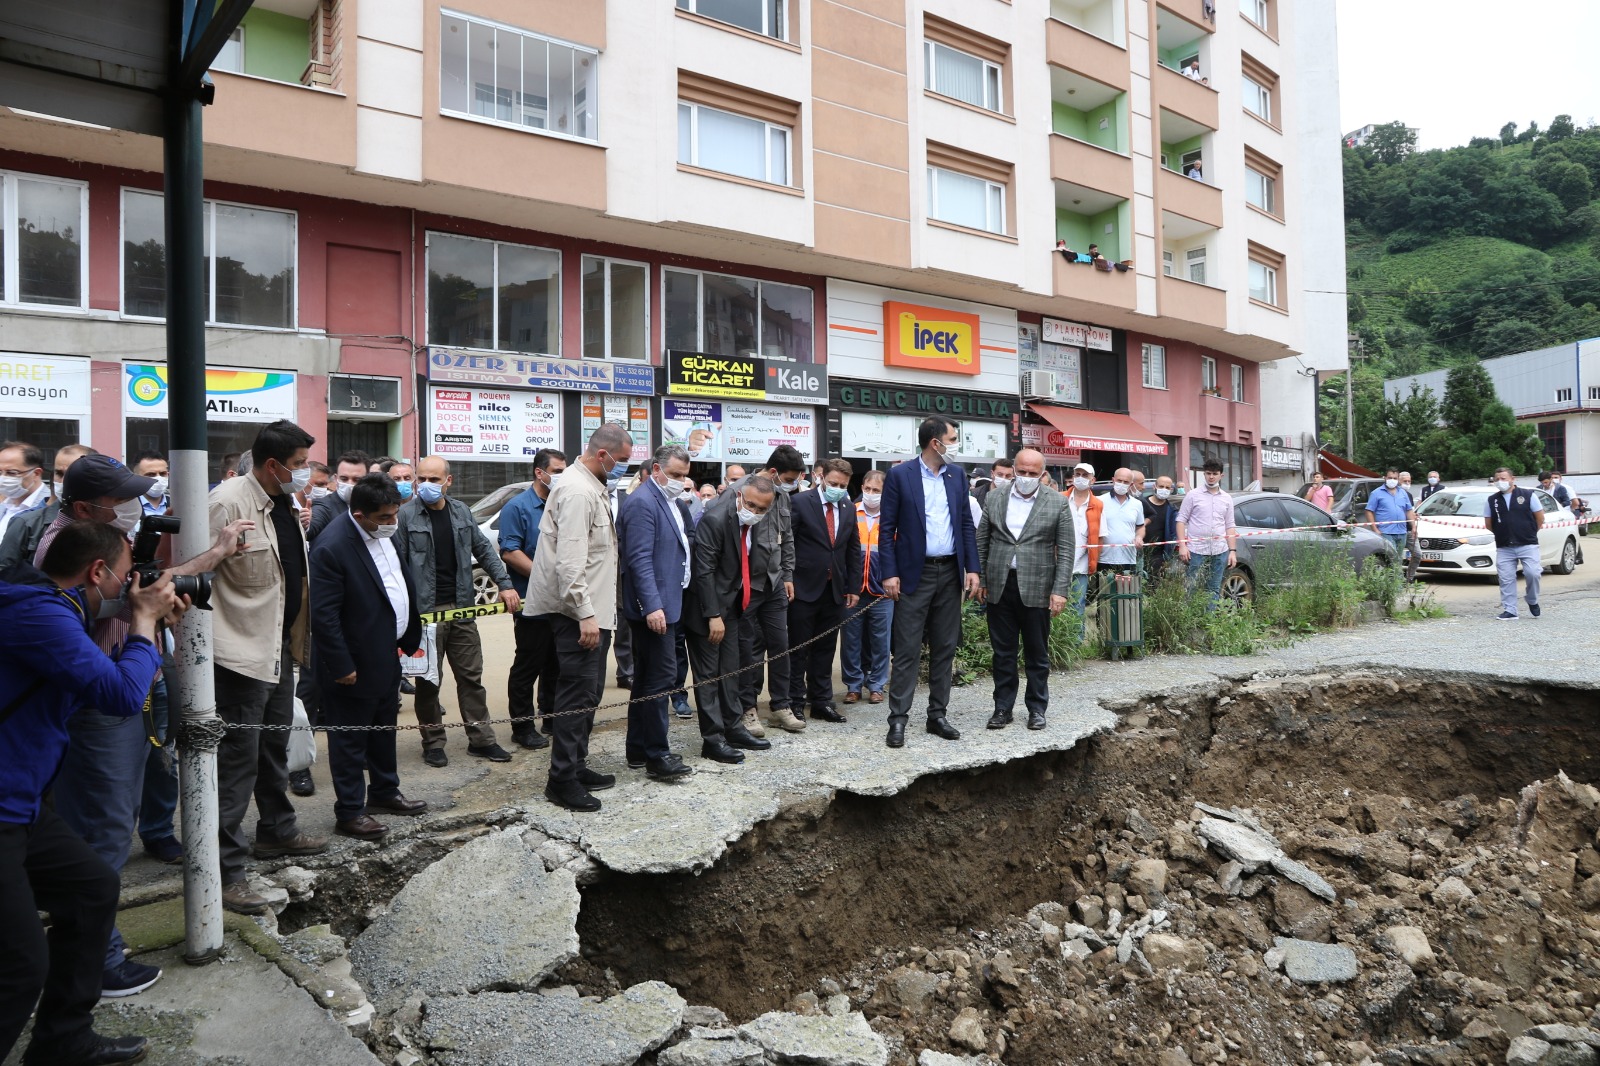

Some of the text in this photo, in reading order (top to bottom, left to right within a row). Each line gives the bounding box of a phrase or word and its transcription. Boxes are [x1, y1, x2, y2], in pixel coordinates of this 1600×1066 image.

[914, 322, 958, 354] İPEK
[1087, 328, 1109, 342] HOME
[432, 350, 612, 379] ÖZER TEKNİK
[682, 355, 754, 374] GÜRKAN
[447, 372, 508, 382] ISITMA
[681, 369, 755, 387] TİCARET
[778, 368, 819, 391] Kale
[541, 378, 599, 390] SOĞUTMA
[0, 386, 68, 400] orasyon
[446, 391, 469, 400] arçelik
[439, 402, 469, 410] VESTEL
[840, 386, 1011, 417] GENÇ MOBİLYA
[478, 403, 511, 412] nilco
[436, 412, 471, 422] BOSCH
[478, 413, 512, 422] SIEMENS
[436, 423, 472, 433] AEG
[525, 425, 554, 434] SHARP
[480, 432, 509, 441] ESKAY
[525, 436, 554, 444] GROUP
[481, 443, 510, 453] AUER
[1261, 447, 1288, 463] TUĞRA
